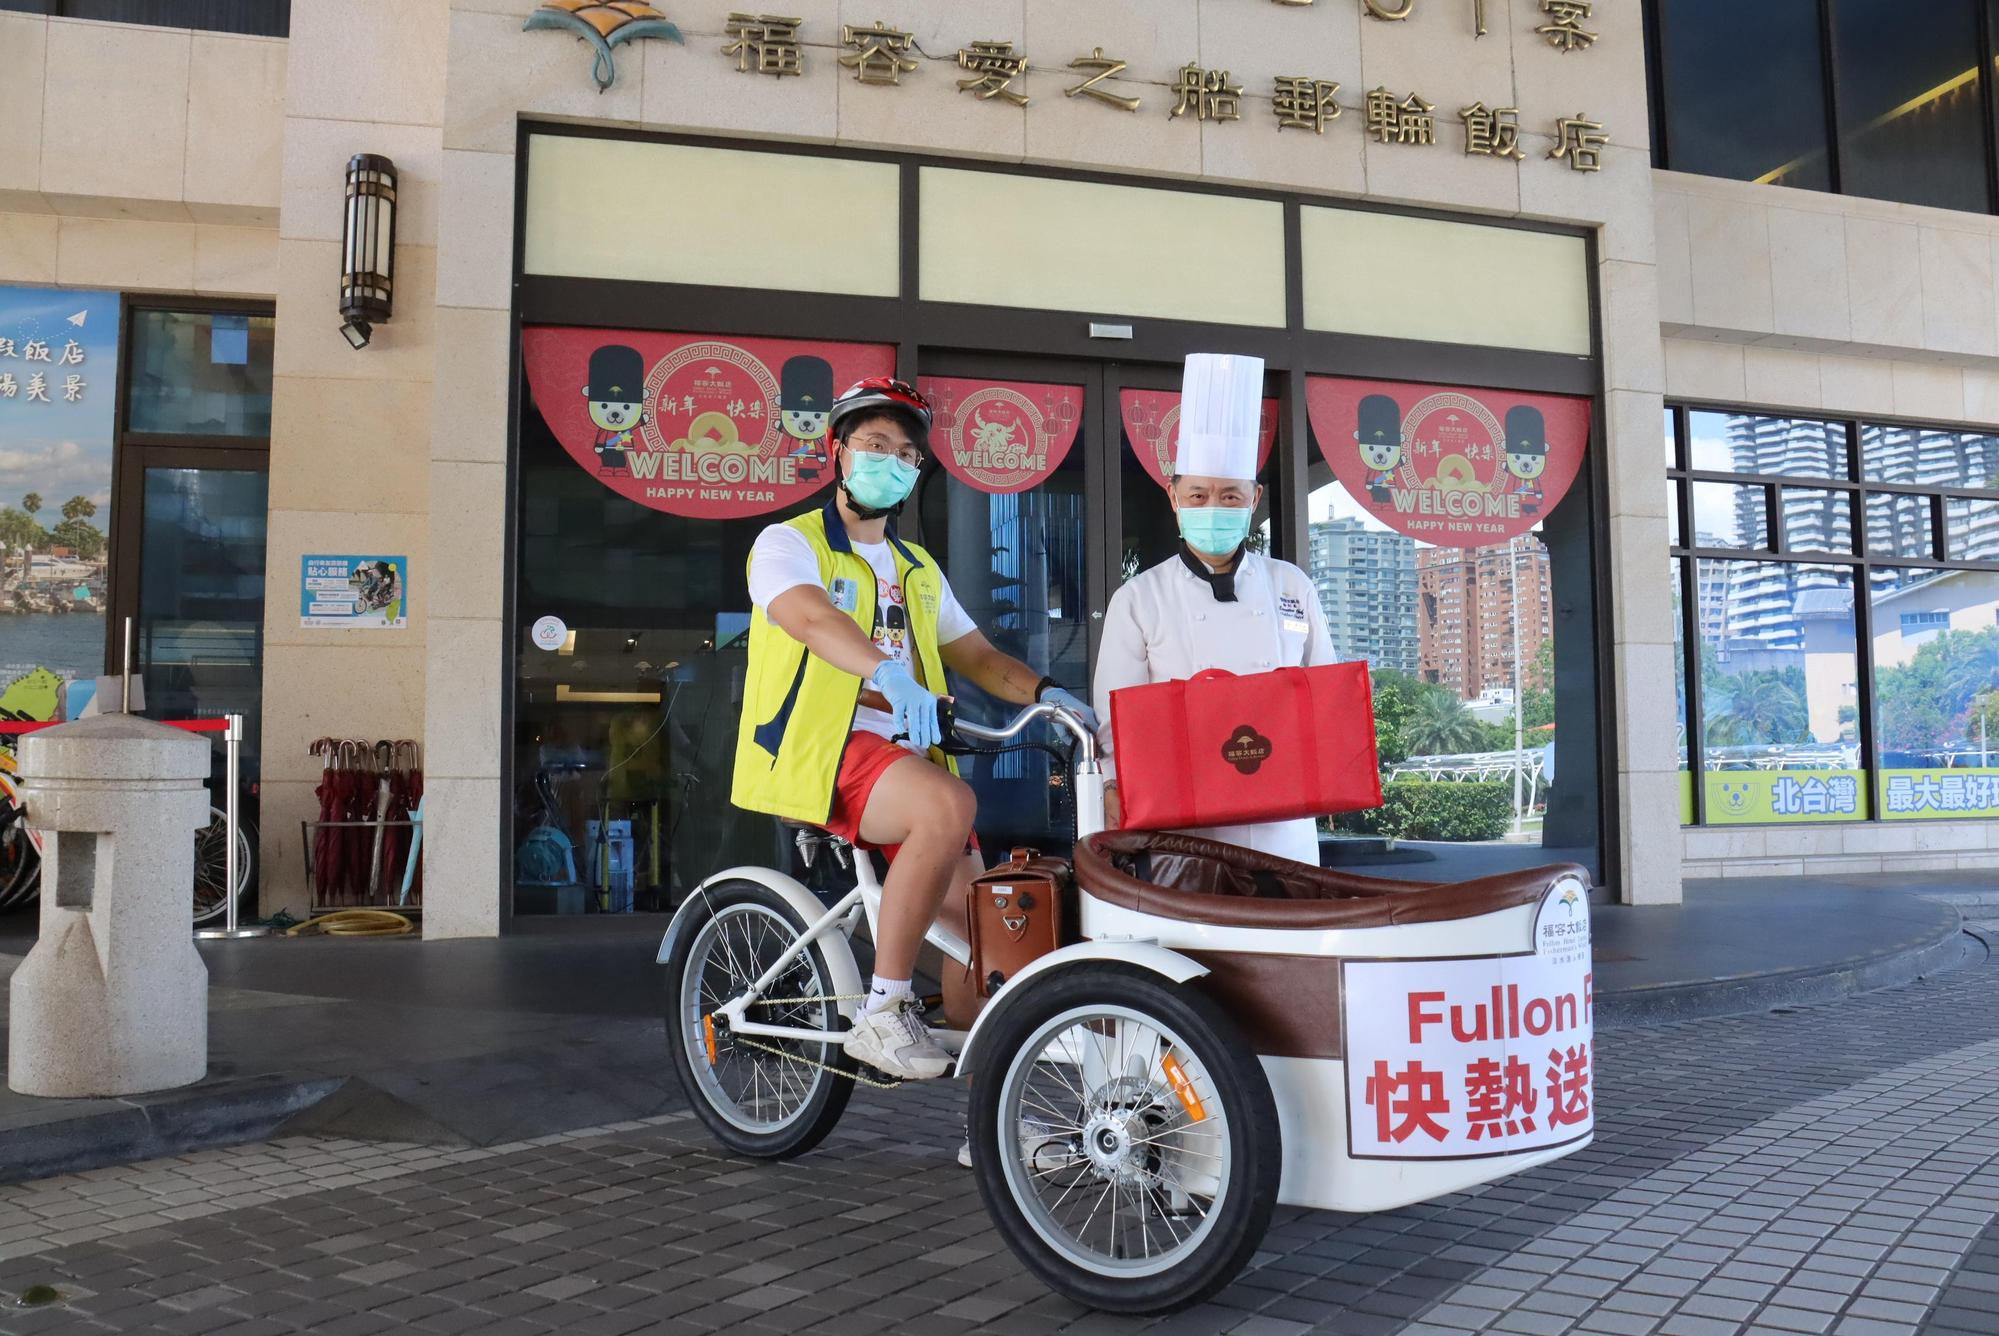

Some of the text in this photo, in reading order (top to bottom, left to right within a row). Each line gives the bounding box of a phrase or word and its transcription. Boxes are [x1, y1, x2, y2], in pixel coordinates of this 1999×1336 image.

[720, 12, 1609, 173] 福容愛之船郵輪飯店
[626, 450, 798, 485] WELCOME
[952, 450, 1047, 471] WELCOME
[646, 487, 775, 502] HAPPY NEW YEAR
[1391, 488, 1520, 518] WELCOME
[1407, 519, 1505, 533] HAPPY NEW YEAR
[1772, 776, 1856, 815] 北台灣
[1407, 984, 1577, 1044] Fullon
[1365, 1040, 1593, 1144] 快熱送
